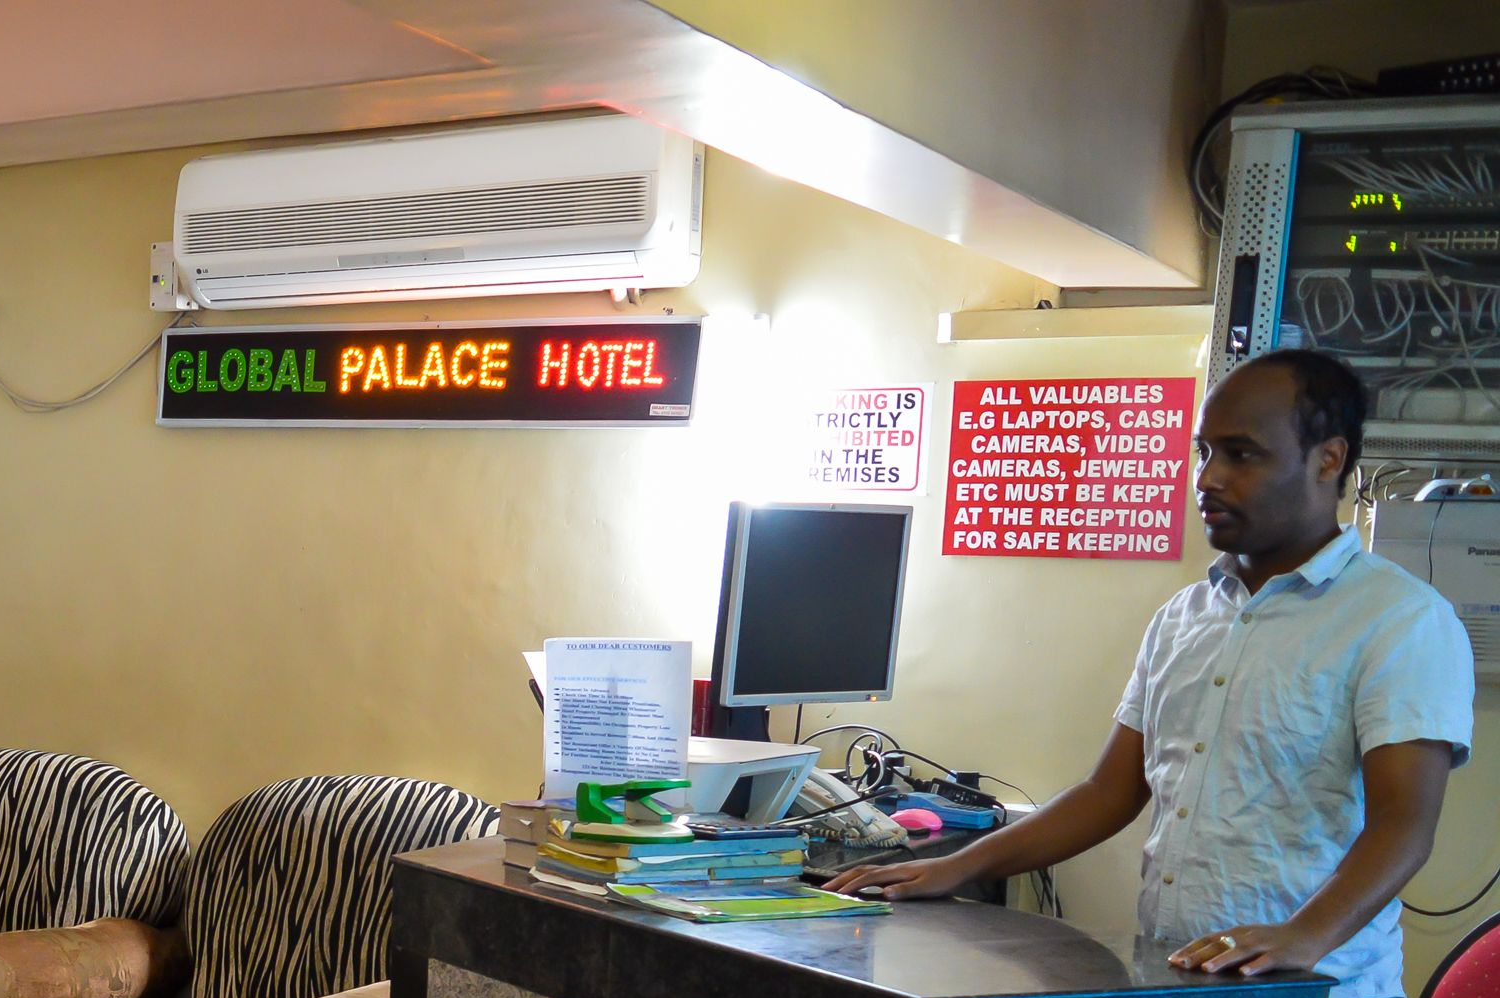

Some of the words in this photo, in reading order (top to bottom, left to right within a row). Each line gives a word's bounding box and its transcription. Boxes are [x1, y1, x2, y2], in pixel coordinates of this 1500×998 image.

[167, 348, 326, 394] GLOBAL
[339, 340, 509, 394] PALACE
[536, 339, 665, 389] HOTEL
[896, 393, 916, 410] IS
[979, 387, 1022, 406] ALL
[1029, 384, 1164, 405] VALUABLES
[813, 411, 902, 428] TRICTLY
[958, 411, 995, 430] E.G
[1002, 410, 1111, 433] LAPTOPS,
[1118, 409, 1183, 429] CASH
[971, 434, 1086, 457] CAMERAS,
[1094, 434, 1166, 454] VIDEO
[842, 449, 883, 464] THE
[808, 467, 900, 483] REMISES
[952, 459, 1066, 481] CAMERAS,
[1073, 459, 1183, 479] JEWELRY
[955, 483, 998, 502] ETC
[1004, 483, 1070, 502] MUST
[1075, 483, 1106, 502] BE
[1112, 484, 1175, 503] KEPT
[953, 507, 983, 525] AT
[988, 507, 1034, 526] THE
[1040, 507, 1172, 528] RECEPTION
[953, 530, 997, 549] FOR
[1003, 531, 1060, 550] SAFE
[1066, 532, 1169, 553] KEEPING
[622, 643, 672, 651] CUSTOMERS
